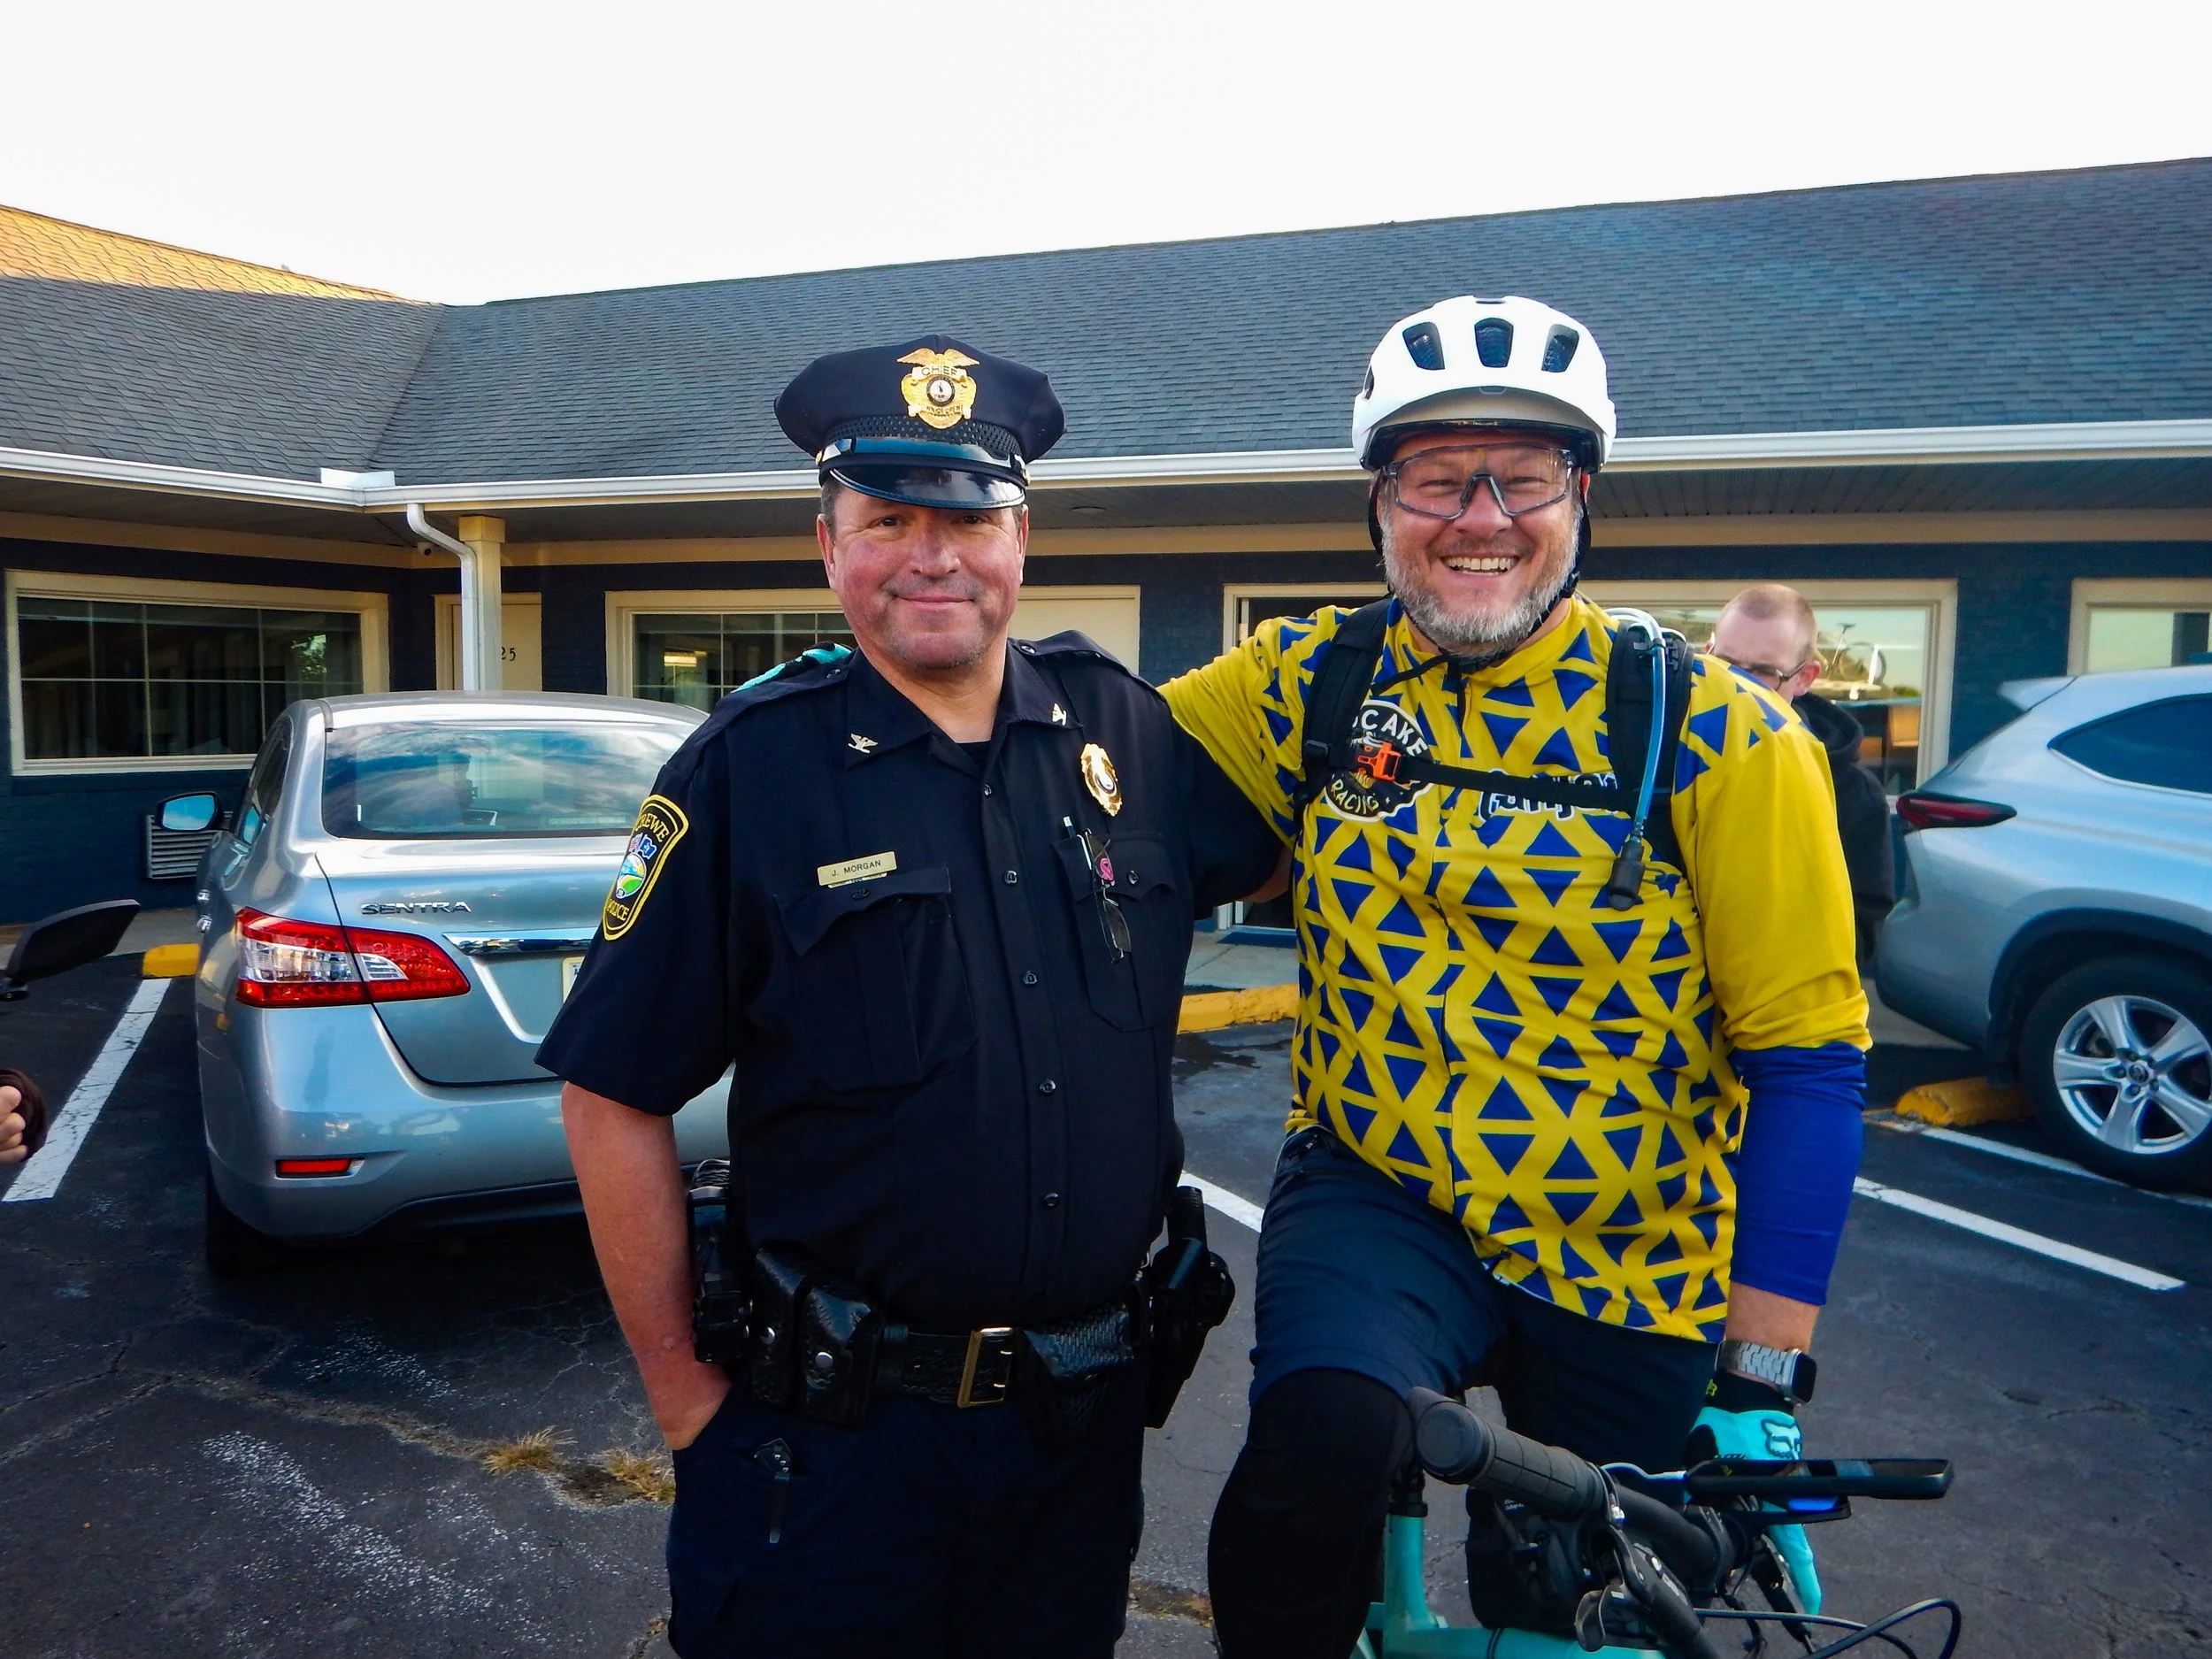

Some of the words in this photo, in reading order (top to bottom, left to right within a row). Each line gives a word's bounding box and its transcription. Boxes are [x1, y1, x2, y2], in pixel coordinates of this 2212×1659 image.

[921, 365, 957, 377] CHIEF
[1352, 709, 1429, 757] CAKE
[1331, 779, 1379, 815] RACING
[843, 859, 881, 874] MORGAN
[361, 901, 472, 915] SENTRA
